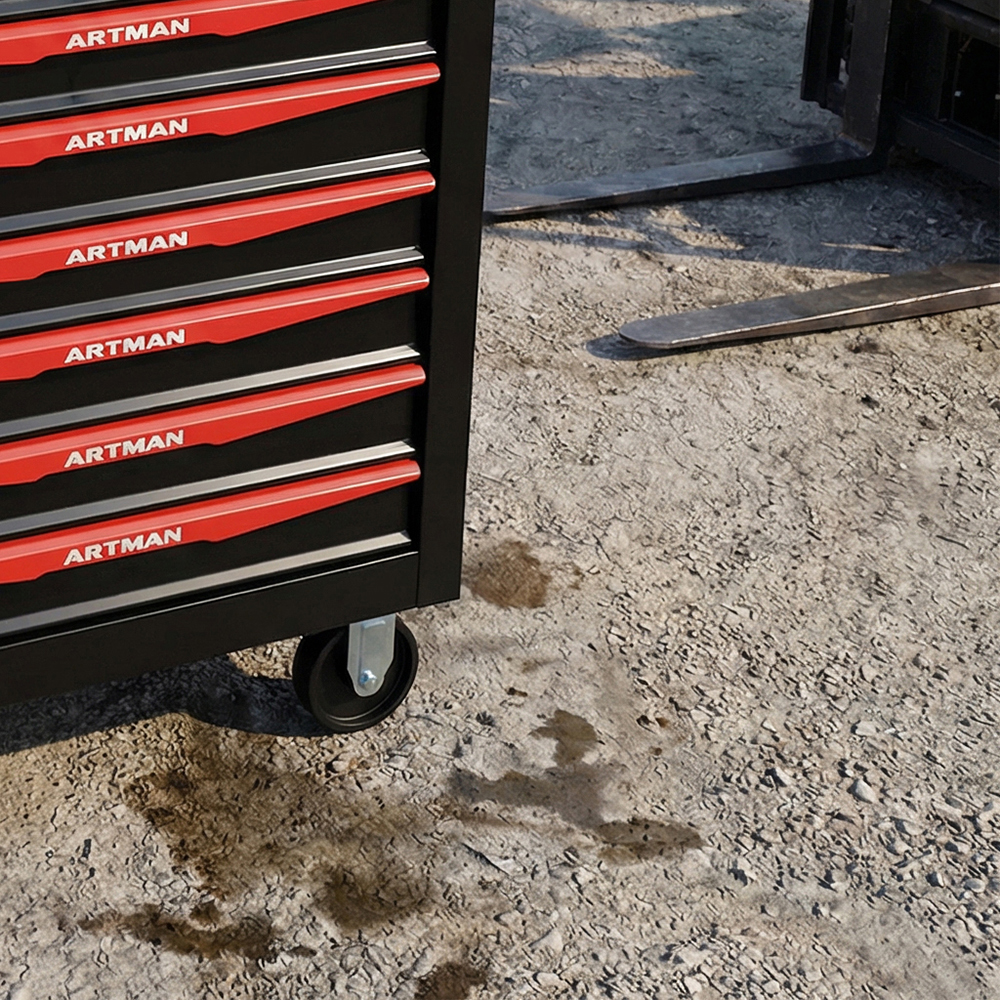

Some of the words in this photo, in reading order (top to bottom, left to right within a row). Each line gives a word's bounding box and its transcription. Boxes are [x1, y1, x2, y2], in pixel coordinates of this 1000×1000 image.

[65, 17, 190, 50] ARTMAN
[64, 117, 188, 151] ARTMAN
[65, 231, 188, 265] ARTMAN
[64, 328, 185, 363] ARTMAN
[64, 429, 184, 467] ARTMAN
[63, 526, 182, 565] ARTMAN
